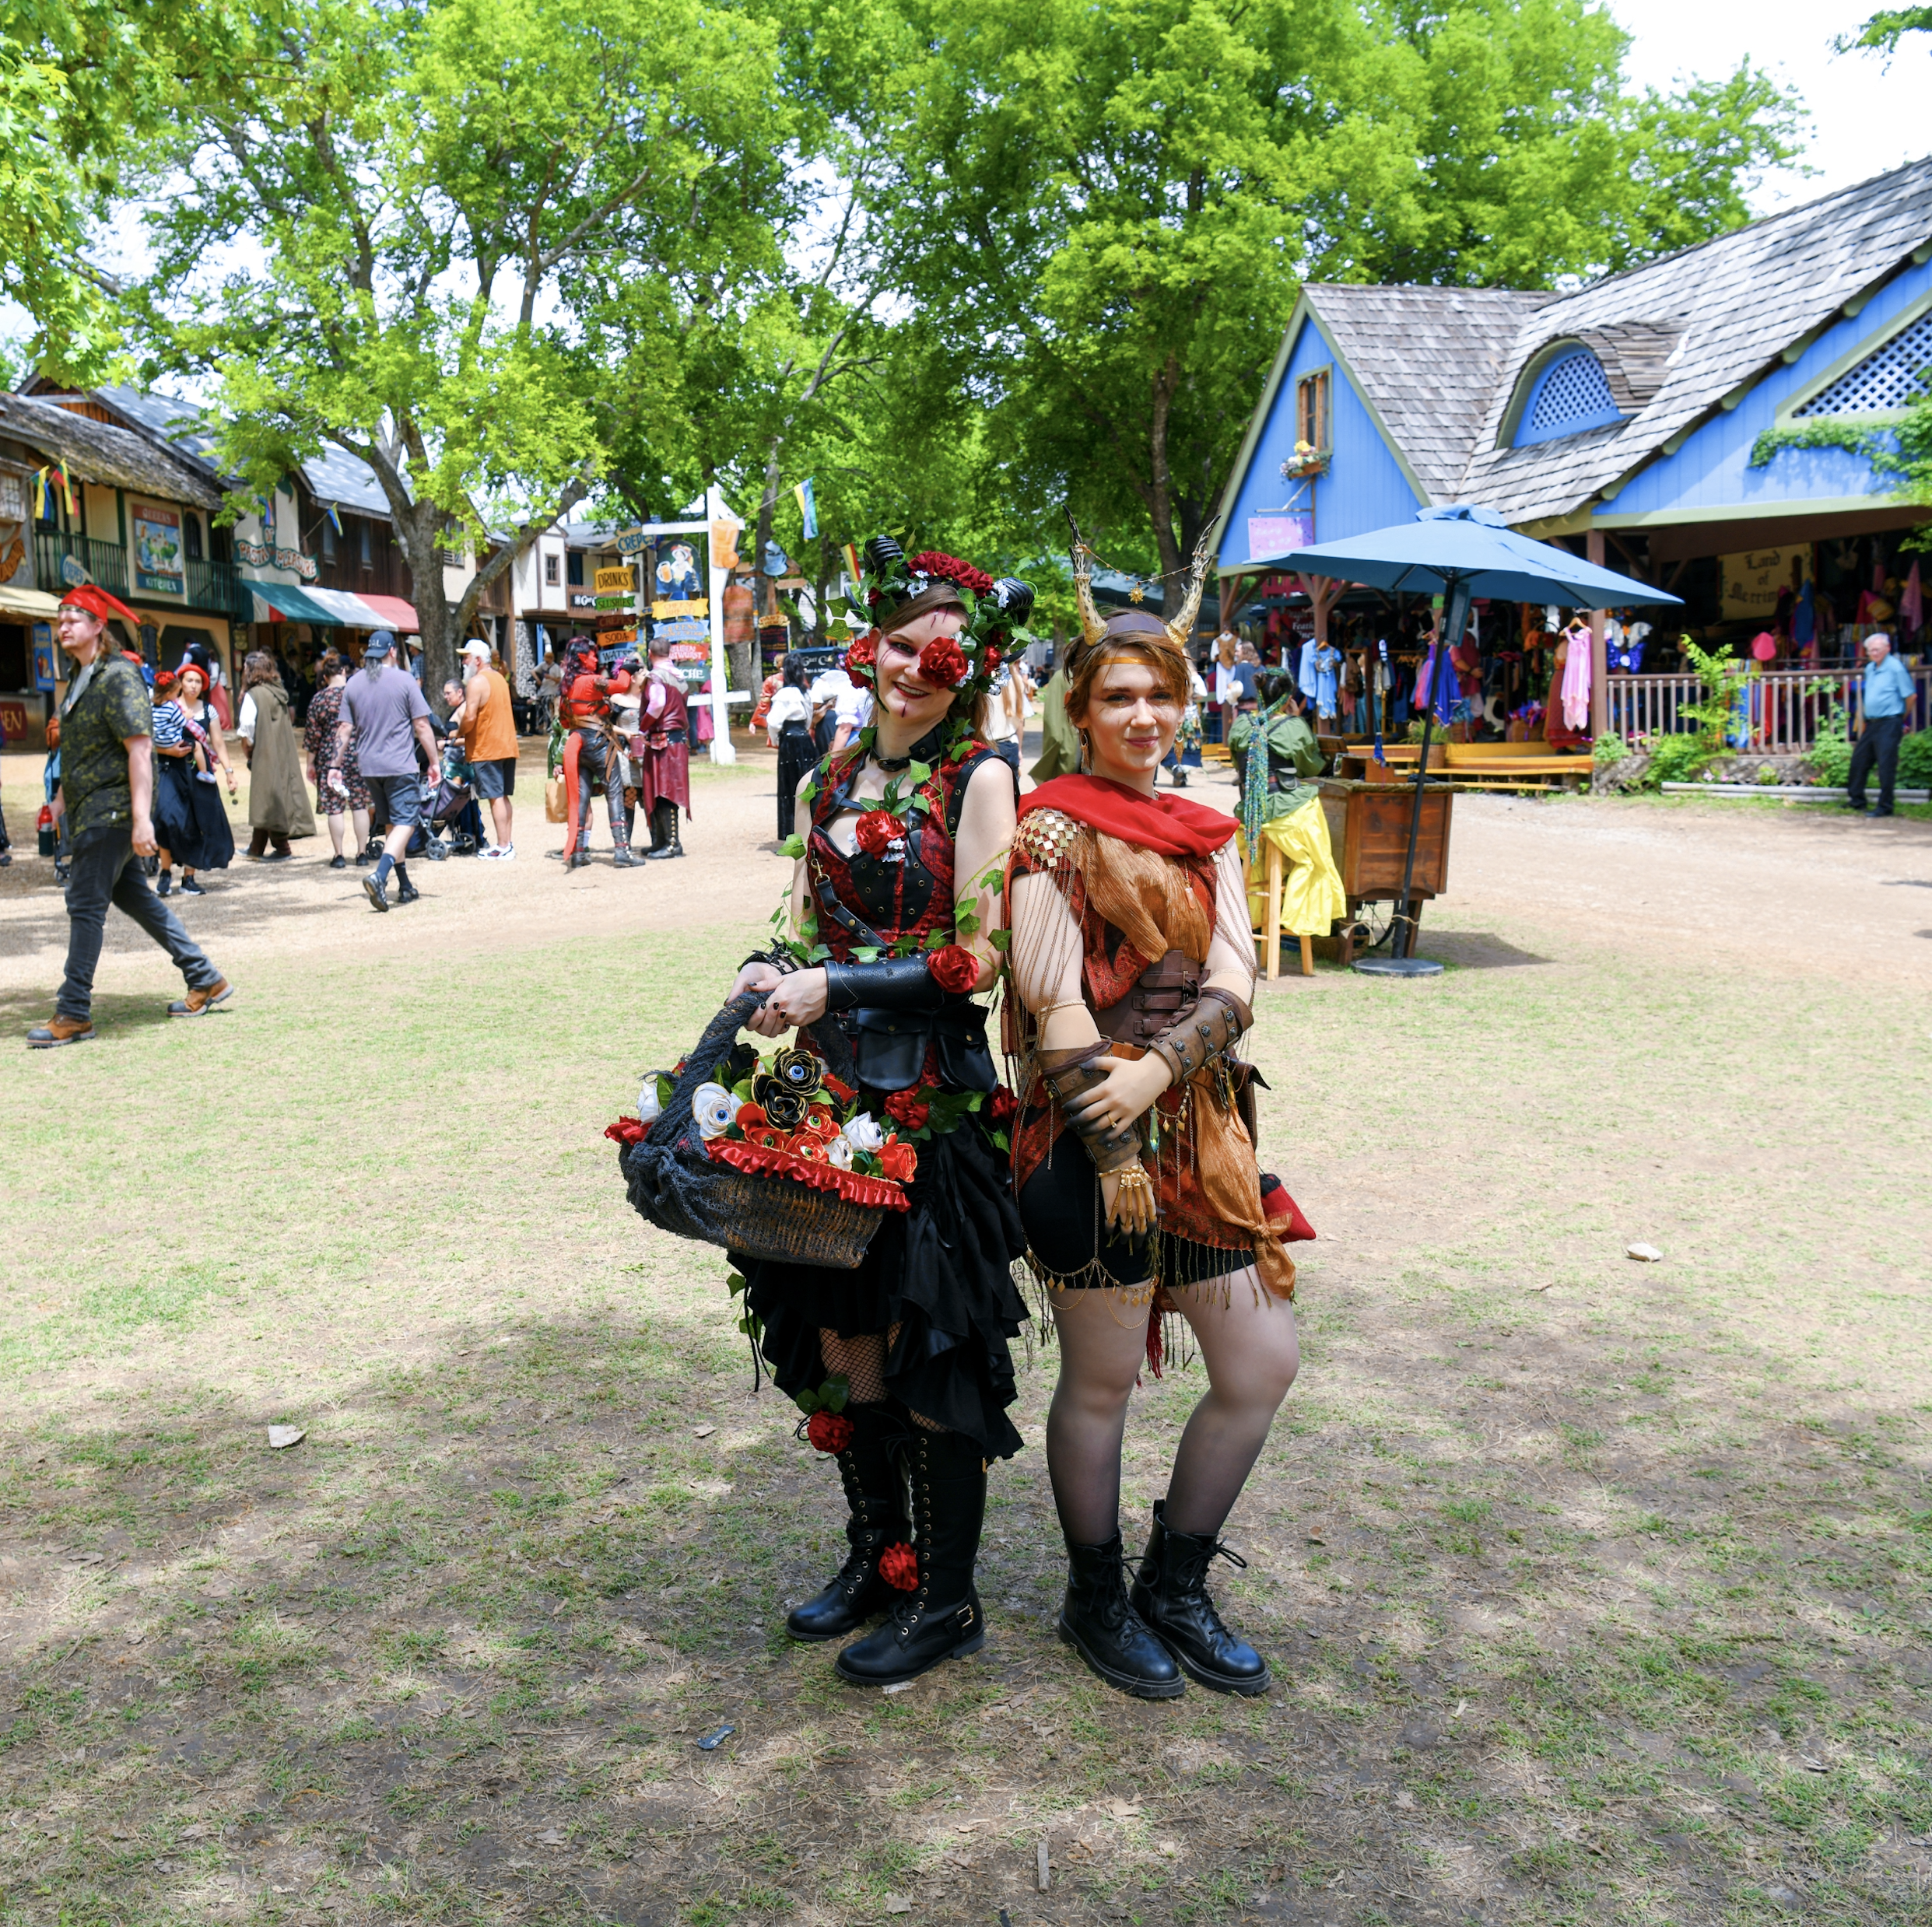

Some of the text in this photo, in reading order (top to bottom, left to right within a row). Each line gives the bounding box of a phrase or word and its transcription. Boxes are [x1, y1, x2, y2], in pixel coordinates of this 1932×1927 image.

[239, 542, 269, 566] PASTA
[1745, 550, 1780, 569] Land
[275, 549, 317, 577] PLEASURE
[598, 572, 629, 589] DRINKS
[1758, 569, 1770, 585] of
[598, 600, 630, 610] SLUSHIES
[599, 616, 633, 627] CREPES
[605, 632, 629, 643] SODA
